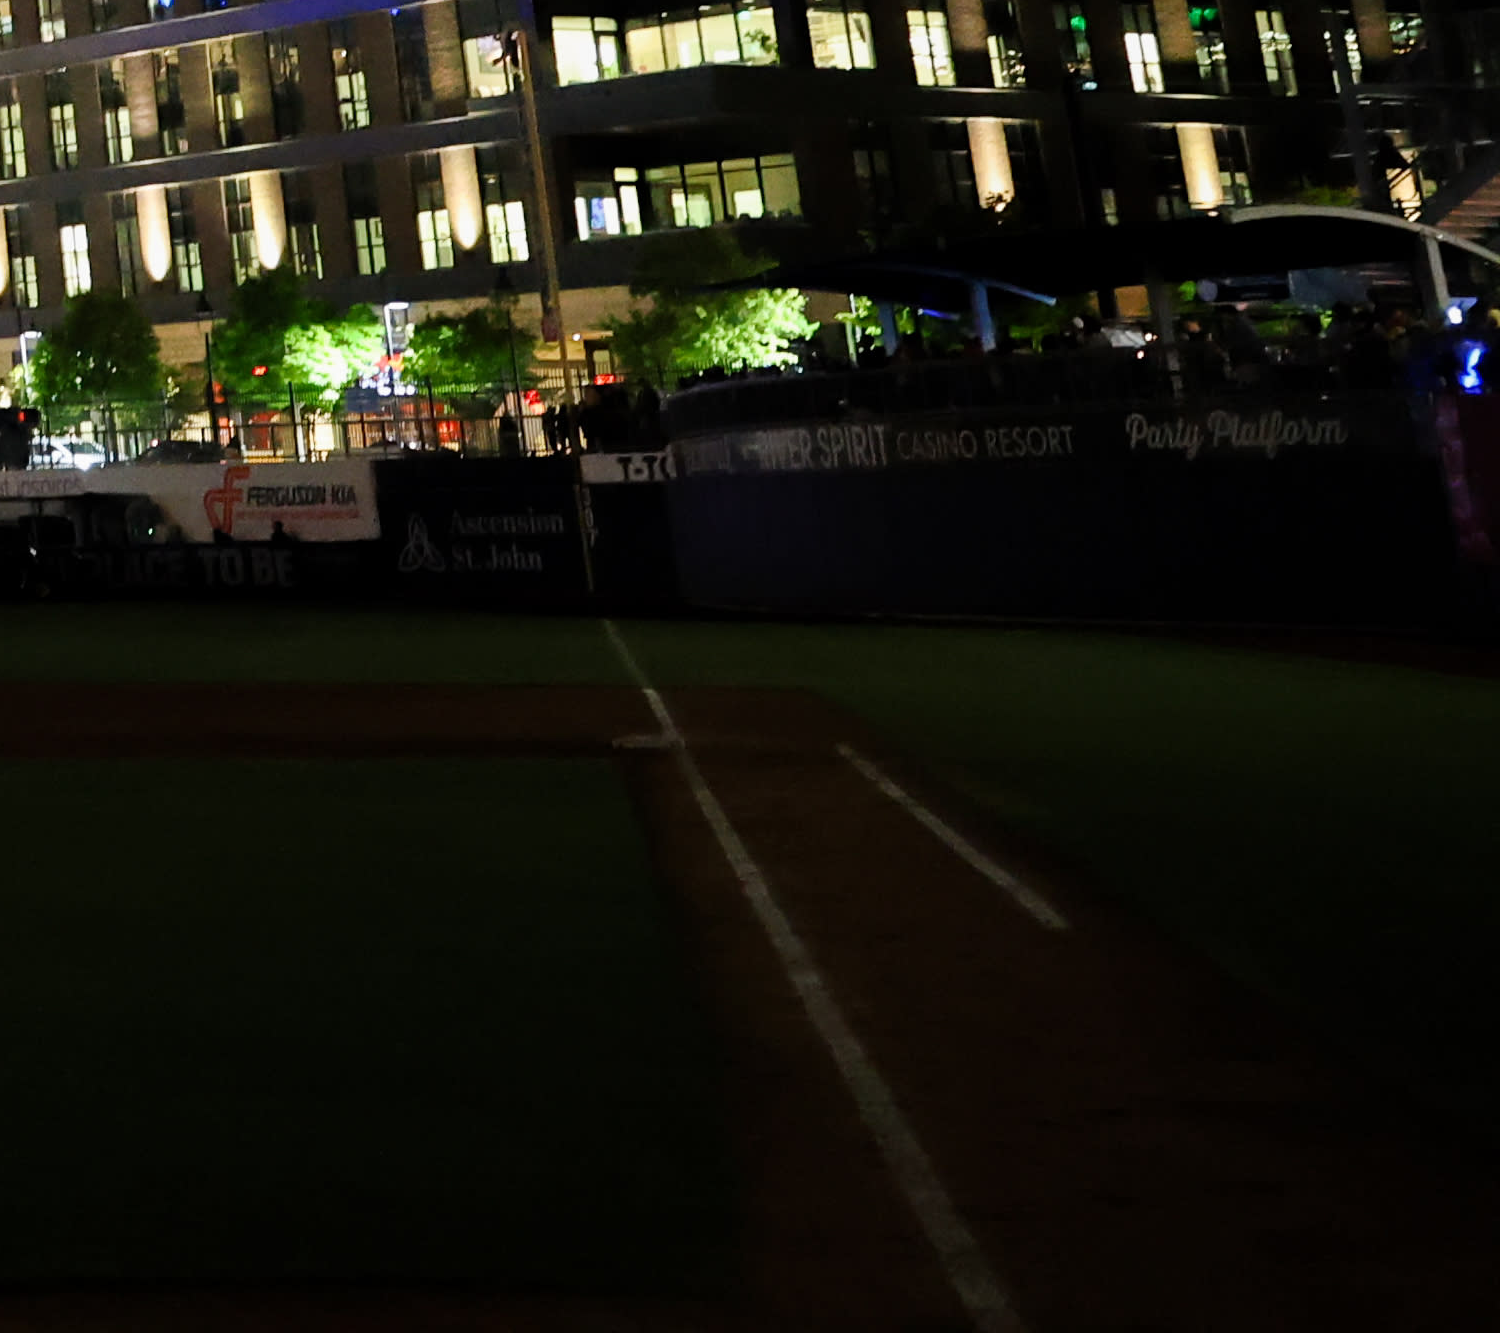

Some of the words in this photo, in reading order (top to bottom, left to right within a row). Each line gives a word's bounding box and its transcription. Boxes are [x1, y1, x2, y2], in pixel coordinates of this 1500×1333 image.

[817, 424, 888, 468] SPIRIT
[896, 430, 978, 461] CASINO
[985, 424, 1074, 457] RESORT
[1125, 413, 1203, 461] Party
[1206, 408, 1347, 460] Platform
[247, 485, 325, 506] FERGUSON
[332, 484, 357, 504] KIA
[450, 507, 564, 534] Ascension
[199, 549, 243, 587] TO
[252, 549, 294, 587] BE
[485, 542, 543, 572] John
